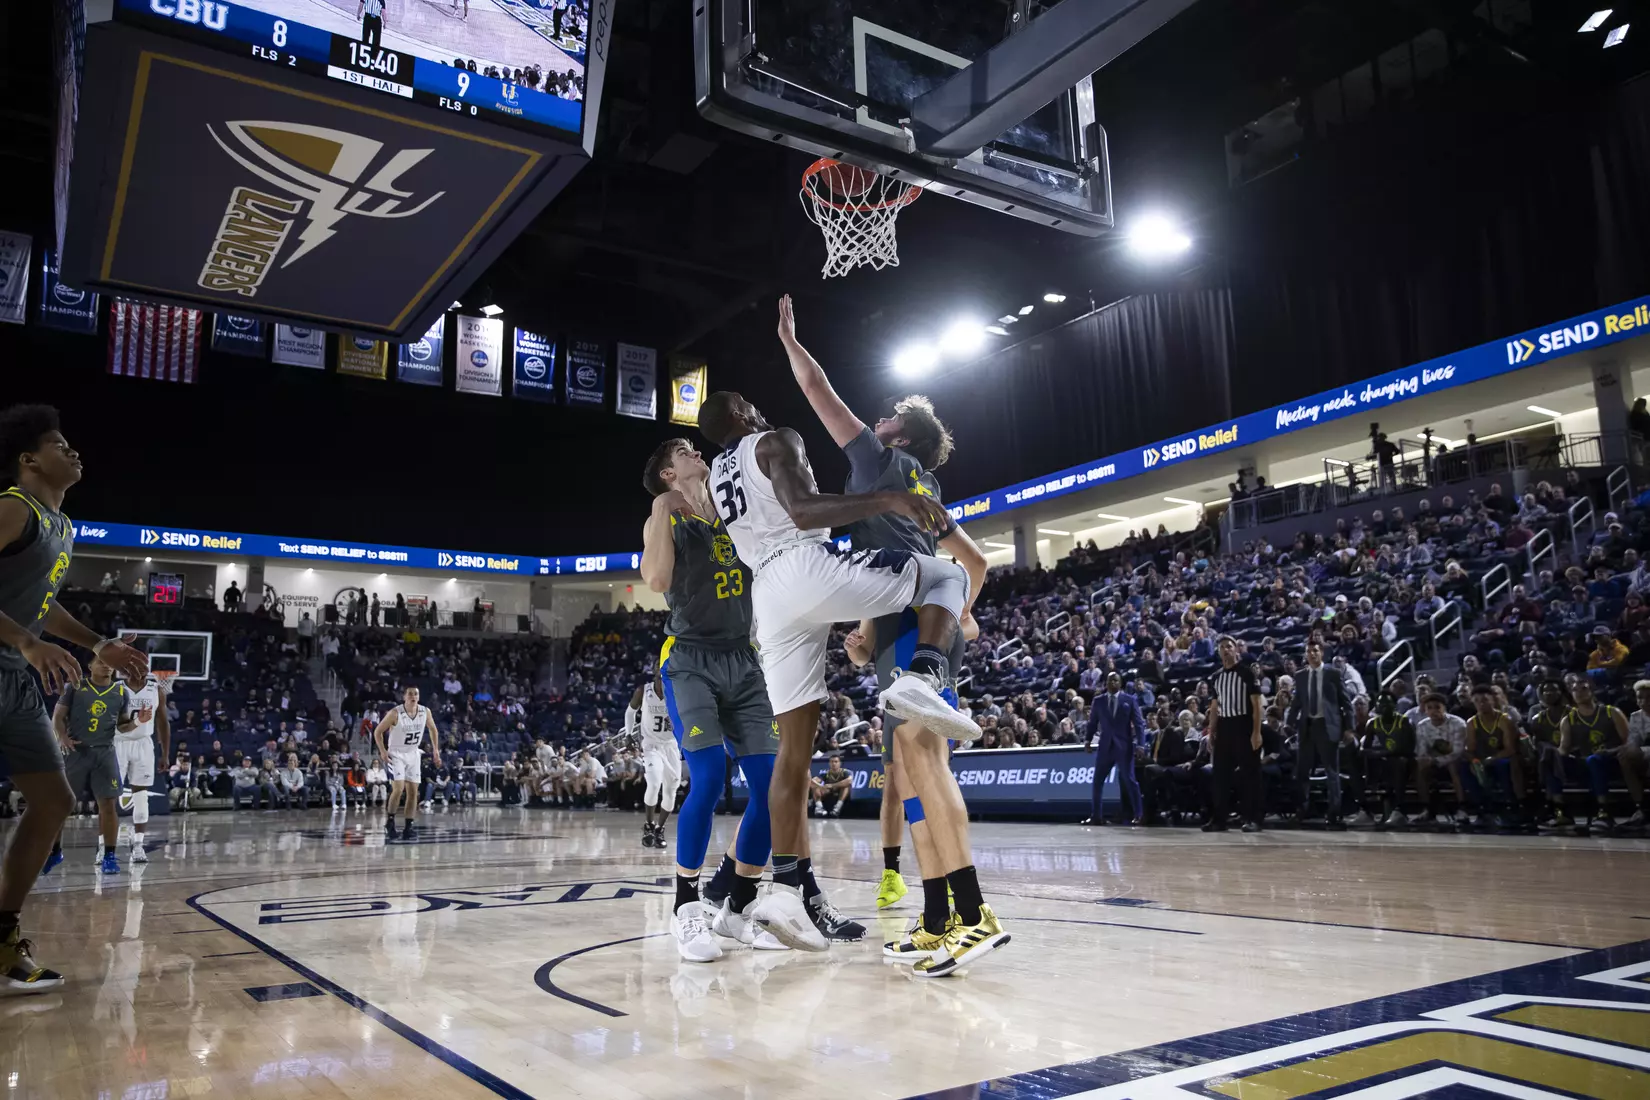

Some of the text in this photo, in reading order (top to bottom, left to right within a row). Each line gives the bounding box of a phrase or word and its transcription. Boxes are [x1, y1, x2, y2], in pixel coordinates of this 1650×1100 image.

[149, 0, 229, 31] CBU
[272, 20, 288, 47] 8
[595, 0, 609, 62] pep
[252, 45, 297, 67] FLS 2
[349, 42, 399, 76] 15:40
[342, 70, 404, 95] 1ST HALF
[457, 72, 470, 98] 9
[439, 96, 478, 116] FLS 0
[197, 186, 304, 297] LANCERS
[40, 304, 95, 319] CHAMPIONS
[216, 328, 264, 342] CHAMPIONS
[523, 330, 547, 343] 2017
[1538, 304, 1650, 353] SEND Reli
[280, 345, 320, 356] CHAMPIONS
[297, 341, 323, 350] REGION
[519, 339, 550, 351] WOMEN'S
[626, 350, 648, 360] 2017
[398, 360, 441, 372] CHAMPIONS
[464, 369, 489, 378] DIVISION
[515, 379, 553, 389] CHAMPIONS
[1276, 403, 1321, 430] Meeting
[1360, 376, 1418, 402] changing
[1422, 365, 1456, 385] lives
[1161, 424, 1238, 461] SEND Relief
[1005, 491, 1022, 504] Text
[1021, 484, 1045, 500] SEND
[1045, 475, 1076, 493] RELIEF
[1077, 474, 1086, 484] to
[964, 497, 990, 517] Relief
[81, 525, 108, 538] lives
[161, 532, 242, 550] SEND Relief
[279, 543, 299, 553] Text
[300, 545, 329, 555] SEND
[330, 547, 366, 558] RELIEF
[367, 550, 377, 559] to
[759, 549, 783, 570] LanceUp
[455, 554, 519, 571] SEND Relief
[575, 553, 639, 572] CBU 8
[714, 569, 743, 599] 23
[153, 585, 176, 603] 20
[282, 594, 319, 602] EQUIPPED
[38, 592, 53, 620] 5
[88, 718, 99, 732] 3
[404, 732, 421, 745] 25
[958, 770, 996, 786] SEND
[997, 768, 1048, 785] RELIEF
[1050, 768, 1065, 784] to
